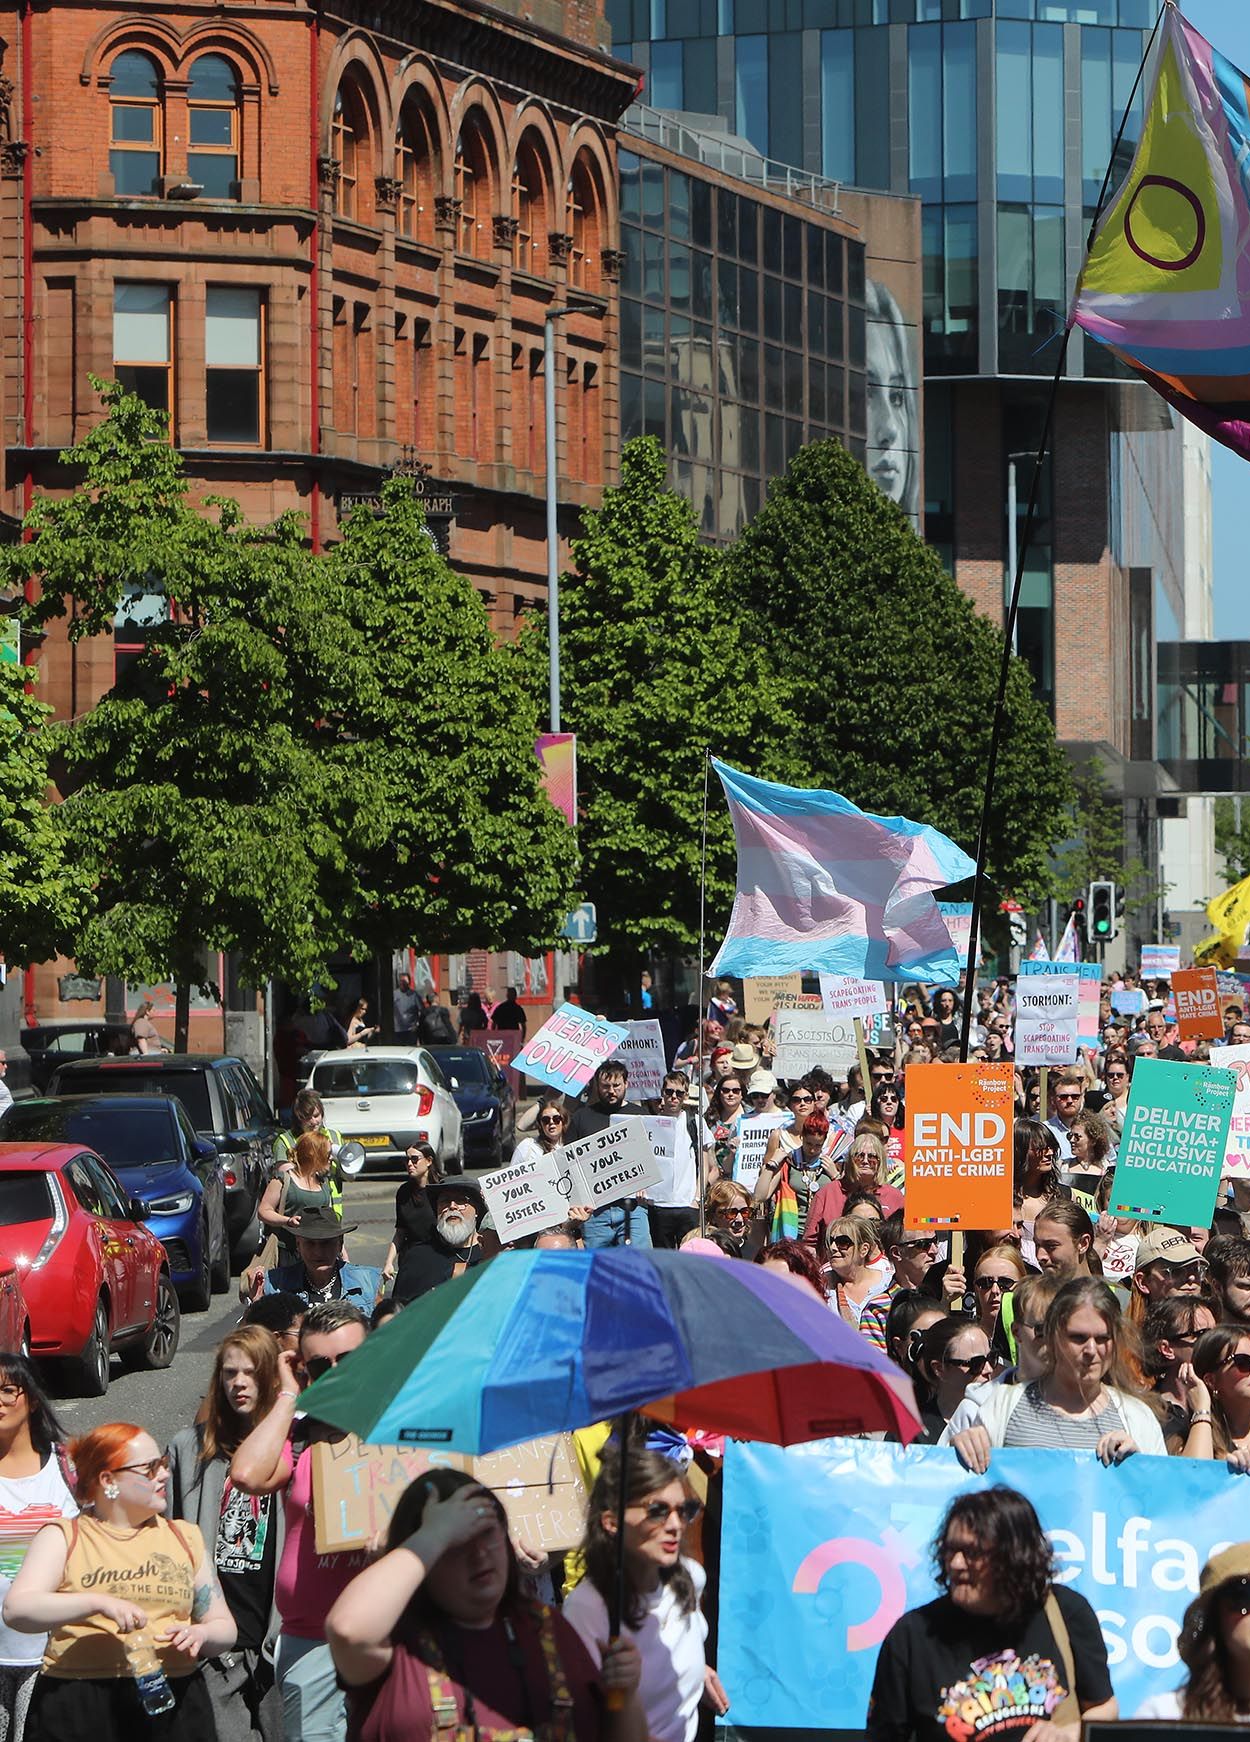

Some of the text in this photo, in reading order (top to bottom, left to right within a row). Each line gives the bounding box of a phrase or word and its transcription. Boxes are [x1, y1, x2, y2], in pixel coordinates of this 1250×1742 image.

[940, 903, 967, 914] ANS
[829, 984, 876, 999] SCAPEGOATING
[1176, 989, 1216, 1006] END
[832, 998, 852, 1009] TRANS
[854, 995, 877, 1006] PEOPLE
[1022, 994, 1073, 1007] STORMONT:
[547, 1010, 620, 1057] TERFS
[1039, 1023, 1055, 1031] STOP
[617, 1038, 659, 1051] ORMONT:
[1023, 1034, 1071, 1043] SCAPEGOATING
[1024, 1045, 1070, 1054] TRANS PEOPLE
[526, 1040, 593, 1084] OUT
[983, 1085, 1007, 1093] Project
[1206, 1088, 1229, 1097] Project
[1133, 1105, 1222, 1132] DELIVER
[743, 1129, 776, 1140] SMA
[914, 1112, 1006, 1147] END
[1130, 1124, 1219, 1147] LGBTQIA+
[566, 1142, 591, 1162] NOT
[597, 1127, 629, 1150] JUST
[1127, 1140, 1217, 1164] INCLUSIVE
[590, 1151, 623, 1173] YOUR
[912, 1148, 1005, 1163] ANTI-LGBT
[912, 1164, 1005, 1177] HATE CRIME
[1124, 1155, 1214, 1178] EDUCATION
[486, 1162, 537, 1190] SUPPORT
[593, 1164, 645, 1195] CISTERS!!
[502, 1182, 533, 1203] YOUR
[505, 1200, 546, 1225] SISTERS
[81, 1560, 159, 1588] Smash
[131, 1584, 151, 1594] THE
